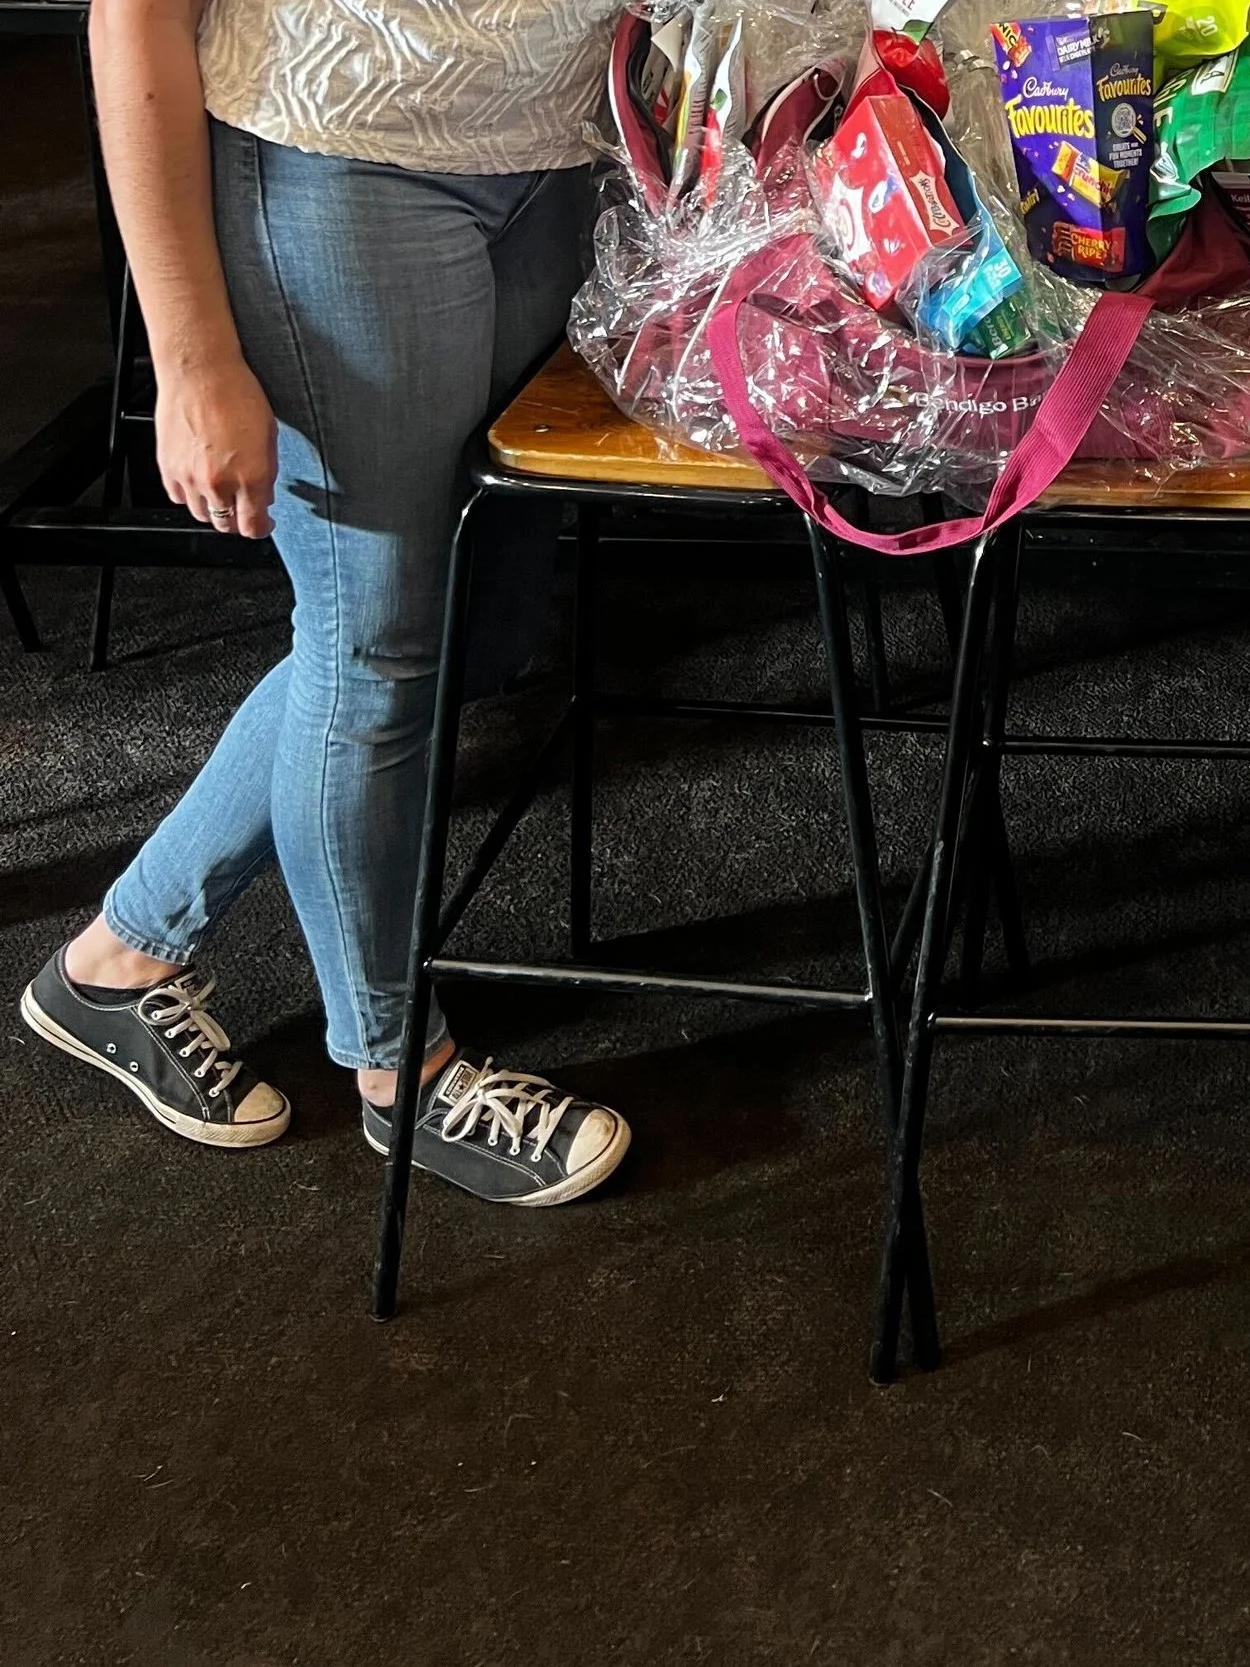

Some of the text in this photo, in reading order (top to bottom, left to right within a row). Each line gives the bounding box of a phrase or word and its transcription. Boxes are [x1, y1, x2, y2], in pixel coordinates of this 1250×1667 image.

[1109, 62, 1140, 79] Cadbury
[1023, 76, 1070, 100] Cadbury
[1096, 73, 1152, 103] Favourites
[1005, 97, 1096, 140] Favourites
[1070, 232, 1112, 251] CHERRY
[1077, 244, 1105, 260] RIPE
